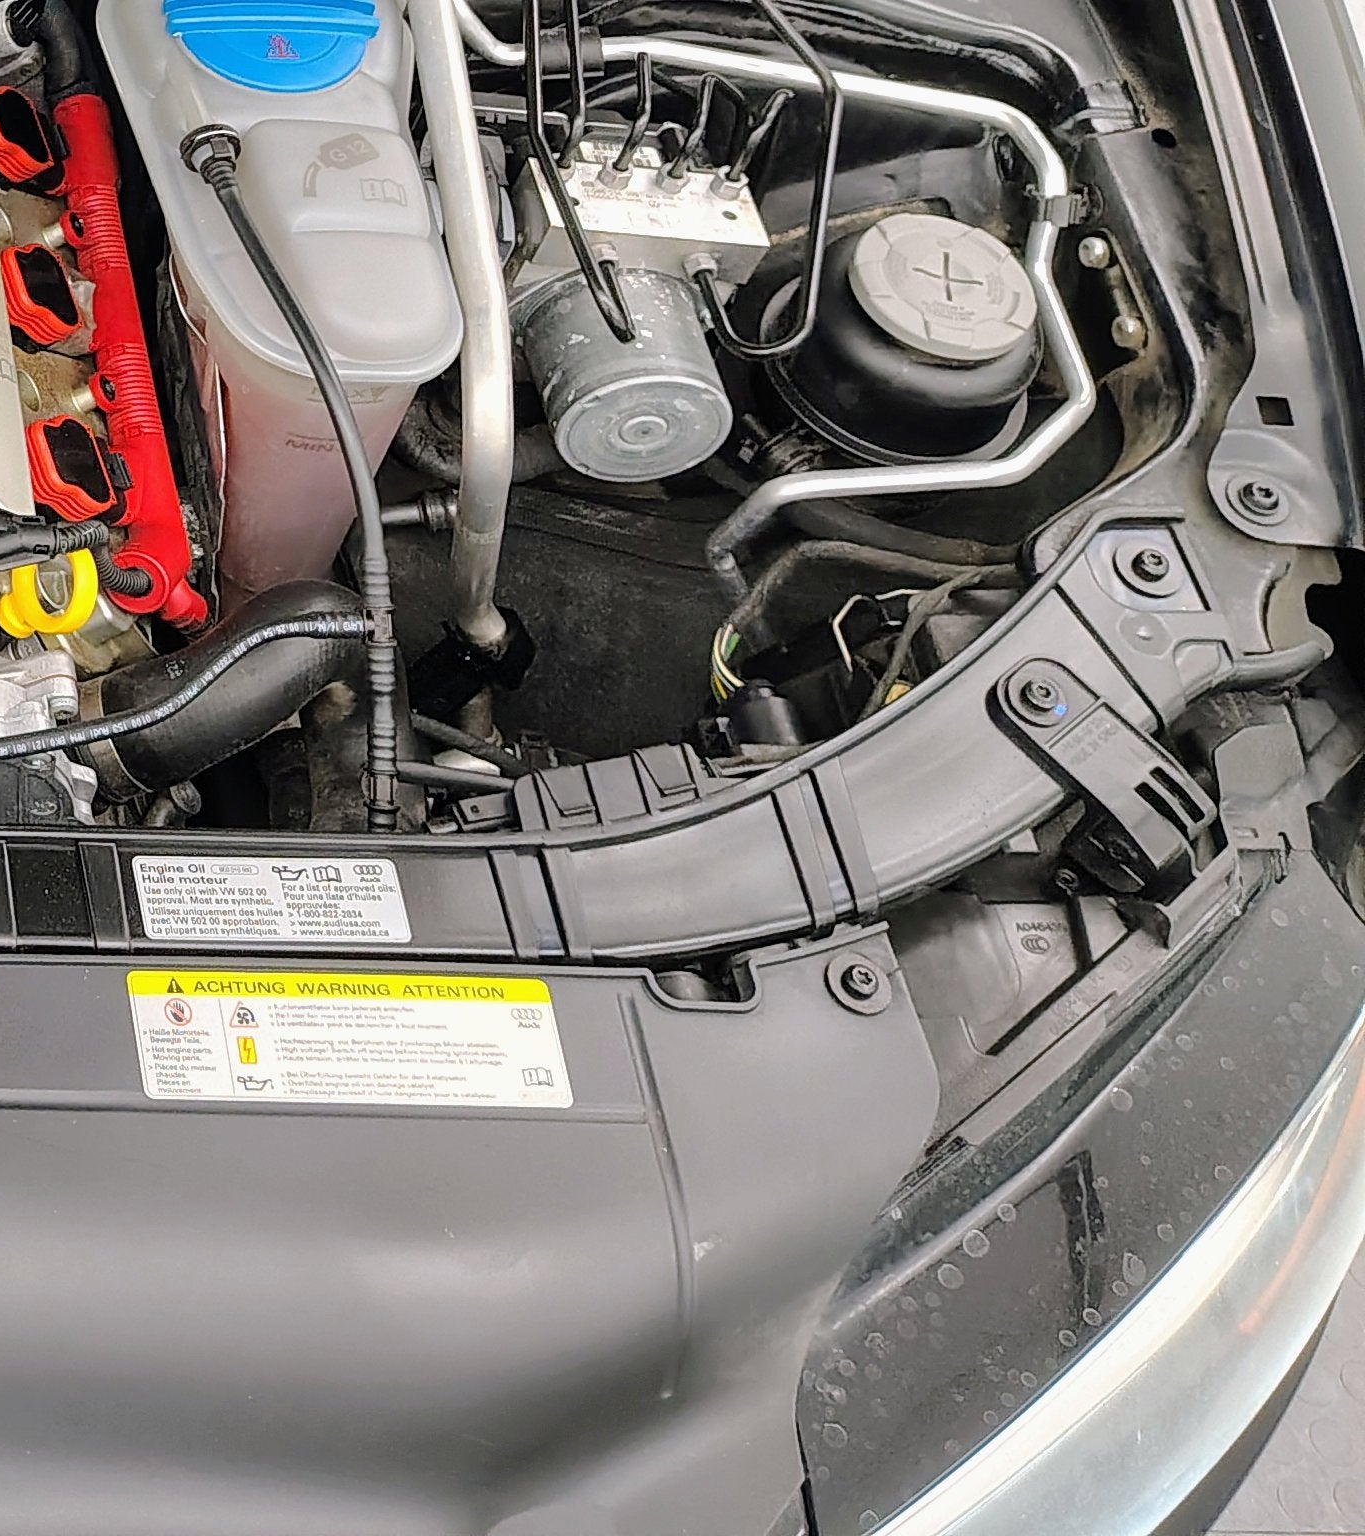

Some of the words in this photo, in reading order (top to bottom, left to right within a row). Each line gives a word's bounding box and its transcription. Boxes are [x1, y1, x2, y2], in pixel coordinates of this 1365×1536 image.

[140, 864, 184, 876] Engine
[188, 864, 205, 873] Oil
[142, 874, 175, 884] Huile
[179, 876, 228, 884] moteur
[144, 886, 161, 894] Use
[164, 887, 182, 896] only
[185, 887, 195, 895] oil
[198, 887, 218, 895] with
[219, 887, 236, 895] VW
[238, 888, 254, 896] 502
[256, 888, 267, 896] 00
[281, 884, 297, 892] For
[306, 884, 320, 892] list
[322, 884, 331, 892] of
[333, 884, 376, 894] approved
[146, 896, 188, 906] approval.
[190, 896, 212, 904] Most
[231, 897, 274, 906] synthetic.
[283, 892, 304, 901] Pour
[326, 892, 344, 901] liste
[148, 907, 181, 915] Utilisez
[182, 908, 236, 917] uniquement
[239, 908, 254, 916] des
[256, 908, 283, 917] huiles
[172, 916, 189, 924] VW
[191, 916, 207, 924] 502
[222, 917, 279, 926] approbation.
[298, 920, 381, 928] www.audiusa.com
[151, 926, 162, 934] La
[165, 927, 197, 936] plupart
[199, 927, 219, 935] sont
[300, 928, 390, 937] www.audicanada.ca
[194, 980, 285, 994] ACHTUNG
[296, 982, 391, 997] WARNING
[402, 984, 505, 1000] ATTENTION
[167, 1047, 191, 1056] engine
[153, 1054, 180, 1062] Moving
